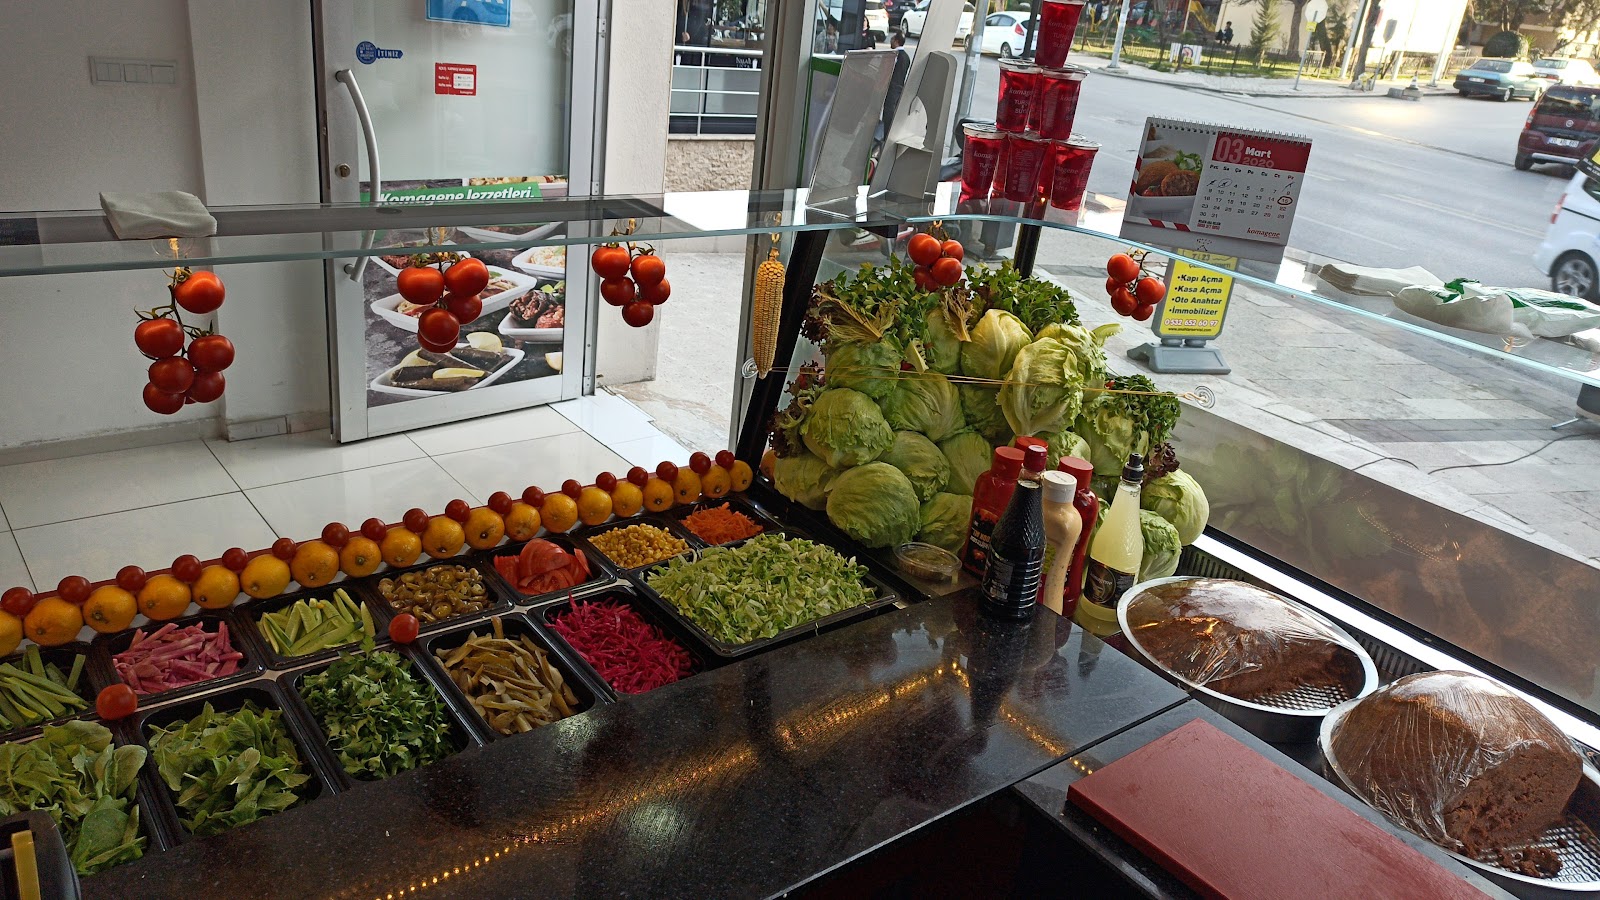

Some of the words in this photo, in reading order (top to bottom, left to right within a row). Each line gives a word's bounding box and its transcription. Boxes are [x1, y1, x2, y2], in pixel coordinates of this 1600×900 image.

[1215, 137, 1243, 164] 03
[1244, 147, 1272, 159] Mart
[1242, 157, 1274, 168] 2020
[379, 192, 465, 207] Komagene
[1247, 227, 1281, 238] komagene
[1181, 274, 1199, 283] Kapı
[1201, 275, 1223, 284] Açma
[1178, 285, 1198, 293] Kasa
[1200, 286, 1222, 295] Açma
[1175, 296, 1189, 304] Oto
[1191, 297, 1222, 305] Anahtar
[1172, 306, 1218, 316] İmmobilizer
